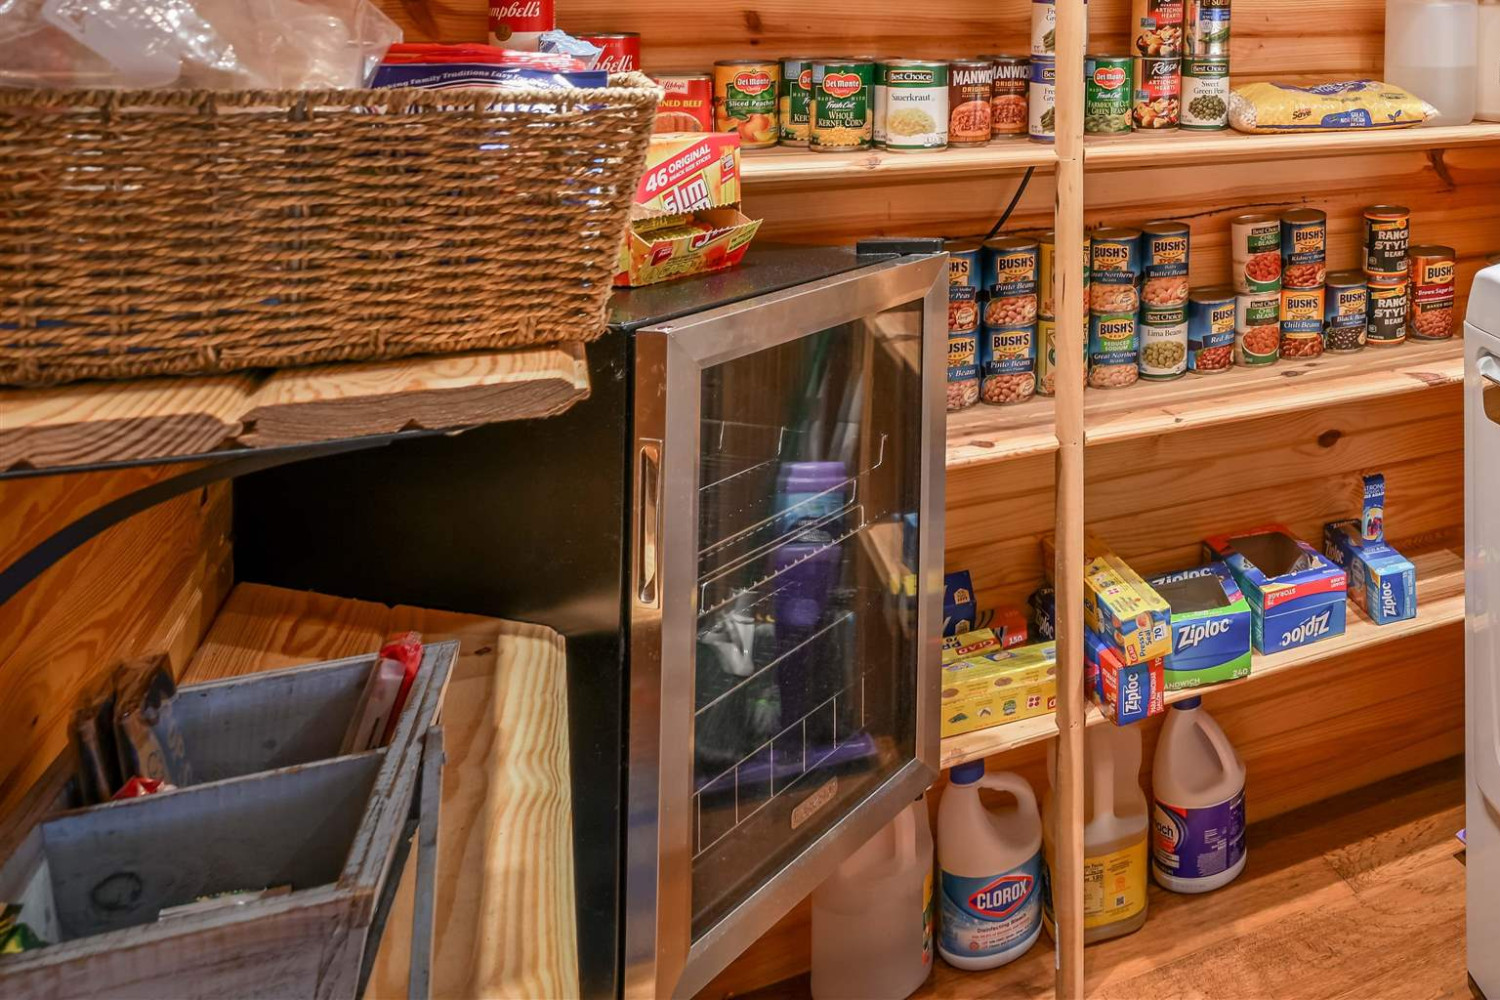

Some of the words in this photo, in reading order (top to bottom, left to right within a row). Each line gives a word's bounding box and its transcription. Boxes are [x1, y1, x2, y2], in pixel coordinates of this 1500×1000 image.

[488, 1, 541, 20] mpbell's
[1151, 61, 1178, 75] Reese
[442, 70, 490, 79] Traditions
[908, 72, 933, 82] Choice
[737, 78, 750, 86] Del
[751, 77, 770, 86] Monte
[823, 79, 838, 89] Del
[838, 79, 860, 89] Monte
[1193, 87, 1212, 95] Green
[891, 93, 931, 102] Sauerkraut
[683, 100, 703, 108] BEEF
[728, 100, 749, 108] Sliced
[645, 168, 668, 192] 46
[668, 144, 710, 173] ORIGINAL
[1295, 228, 1324, 242] BUSH'S
[1378, 230, 1408, 241] RANCH
[1153, 238, 1186, 253] BUSH'S
[1094, 246, 1128, 259] BUSH'S
[1384, 250, 1405, 258] BEANS
[999, 255, 1034, 271] BUSH'S
[1103, 270, 1133, 279] Northern
[1149, 269, 1169, 277] Butter
[995, 282, 1013, 291] Pinto
[1014, 282, 1034, 290] Beans
[1287, 298, 1318, 309] BUSH'S
[1339, 293, 1366, 305] BUSH'S
[1377, 298, 1407, 308] RANCH
[1160, 312, 1182, 321] Choice
[1099, 321, 1134, 335] BUSH'S
[1283, 321, 1300, 329] Chili
[1147, 329, 1163, 337] Lima
[993, 333, 1030, 349] BUSH'S
[1210, 335, 1223, 343] Red
[1112, 351, 1137, 359] Northern
[990, 360, 1010, 368] Pinto
[1011, 358, 1031, 368] Beans
[1267, 588, 1296, 599] STORAGE
[1381, 582, 1396, 617] Ziploc
[1154, 627, 1162, 639] 70
[1178, 617, 1231, 648] Ziploc
[1280, 610, 1331, 646] Ziploc
[1232, 668, 1248, 679] 240
[1164, 677, 1200, 690] ANDWICH
[1124, 673, 1140, 713] Ziploc
[977, 878, 1027, 909] CLOROX
